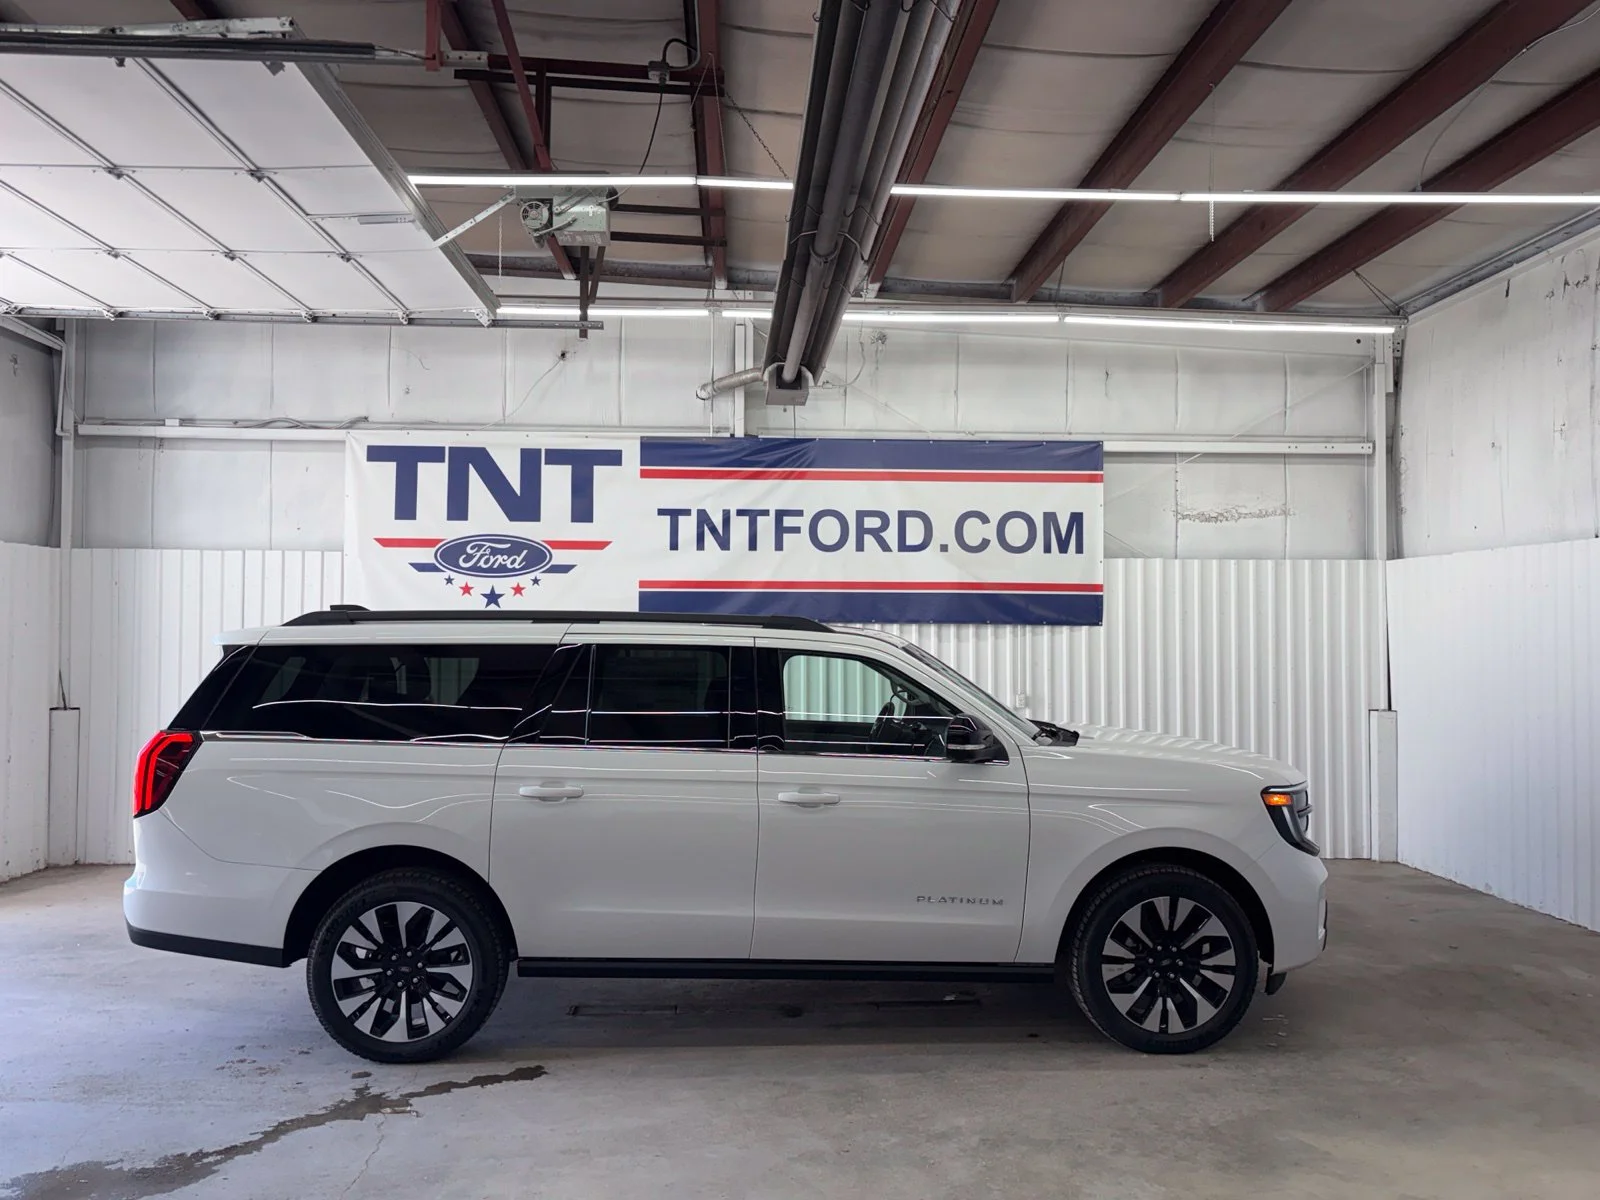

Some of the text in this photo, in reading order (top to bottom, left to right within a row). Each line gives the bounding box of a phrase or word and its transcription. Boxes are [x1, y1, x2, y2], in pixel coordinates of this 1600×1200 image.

[366, 445, 623, 523] TNT
[657, 508, 1085, 555] TNTFORD.COM
[458, 541, 527, 569] Ford
[916, 895, 1004, 906] PLATINUM
